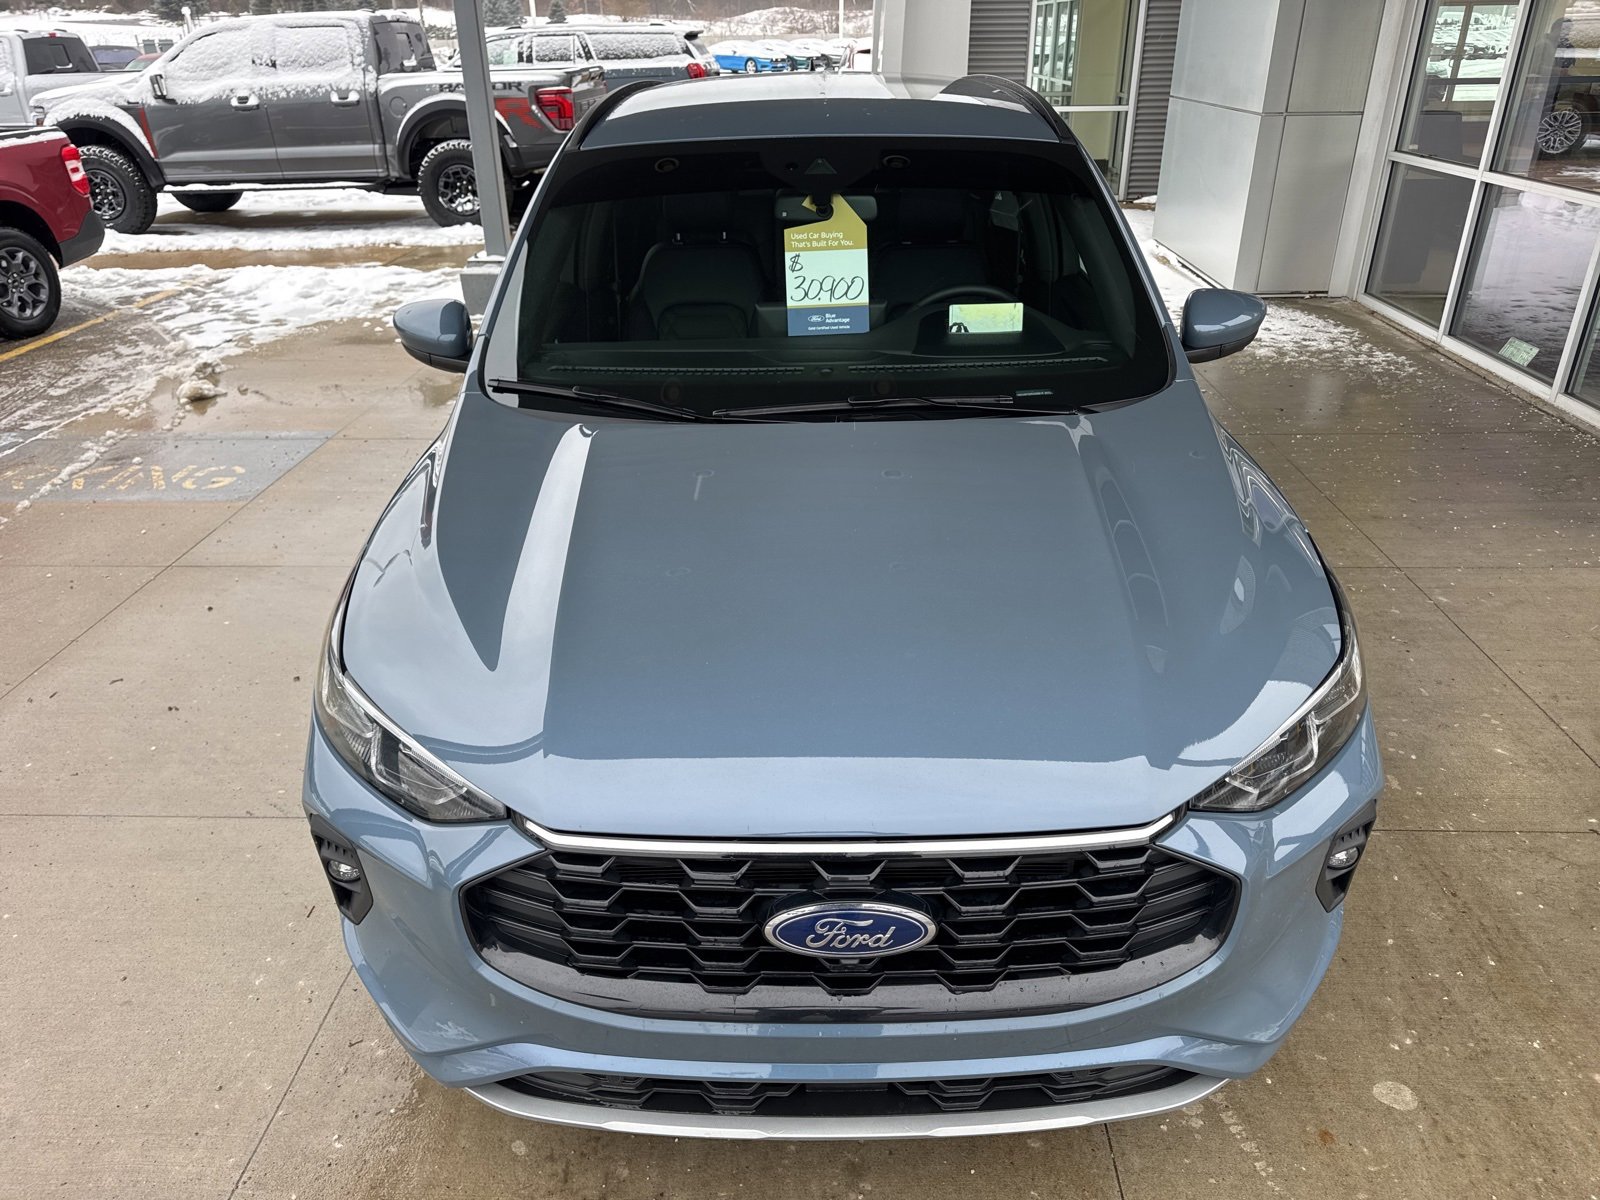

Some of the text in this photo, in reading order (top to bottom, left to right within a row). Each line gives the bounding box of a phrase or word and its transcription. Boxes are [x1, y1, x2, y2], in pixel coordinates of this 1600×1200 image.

[791, 232, 808, 240] Used
[821, 231, 843, 239] Buying
[789, 253, 804, 273] $
[805, 918, 896, 948] Ford
